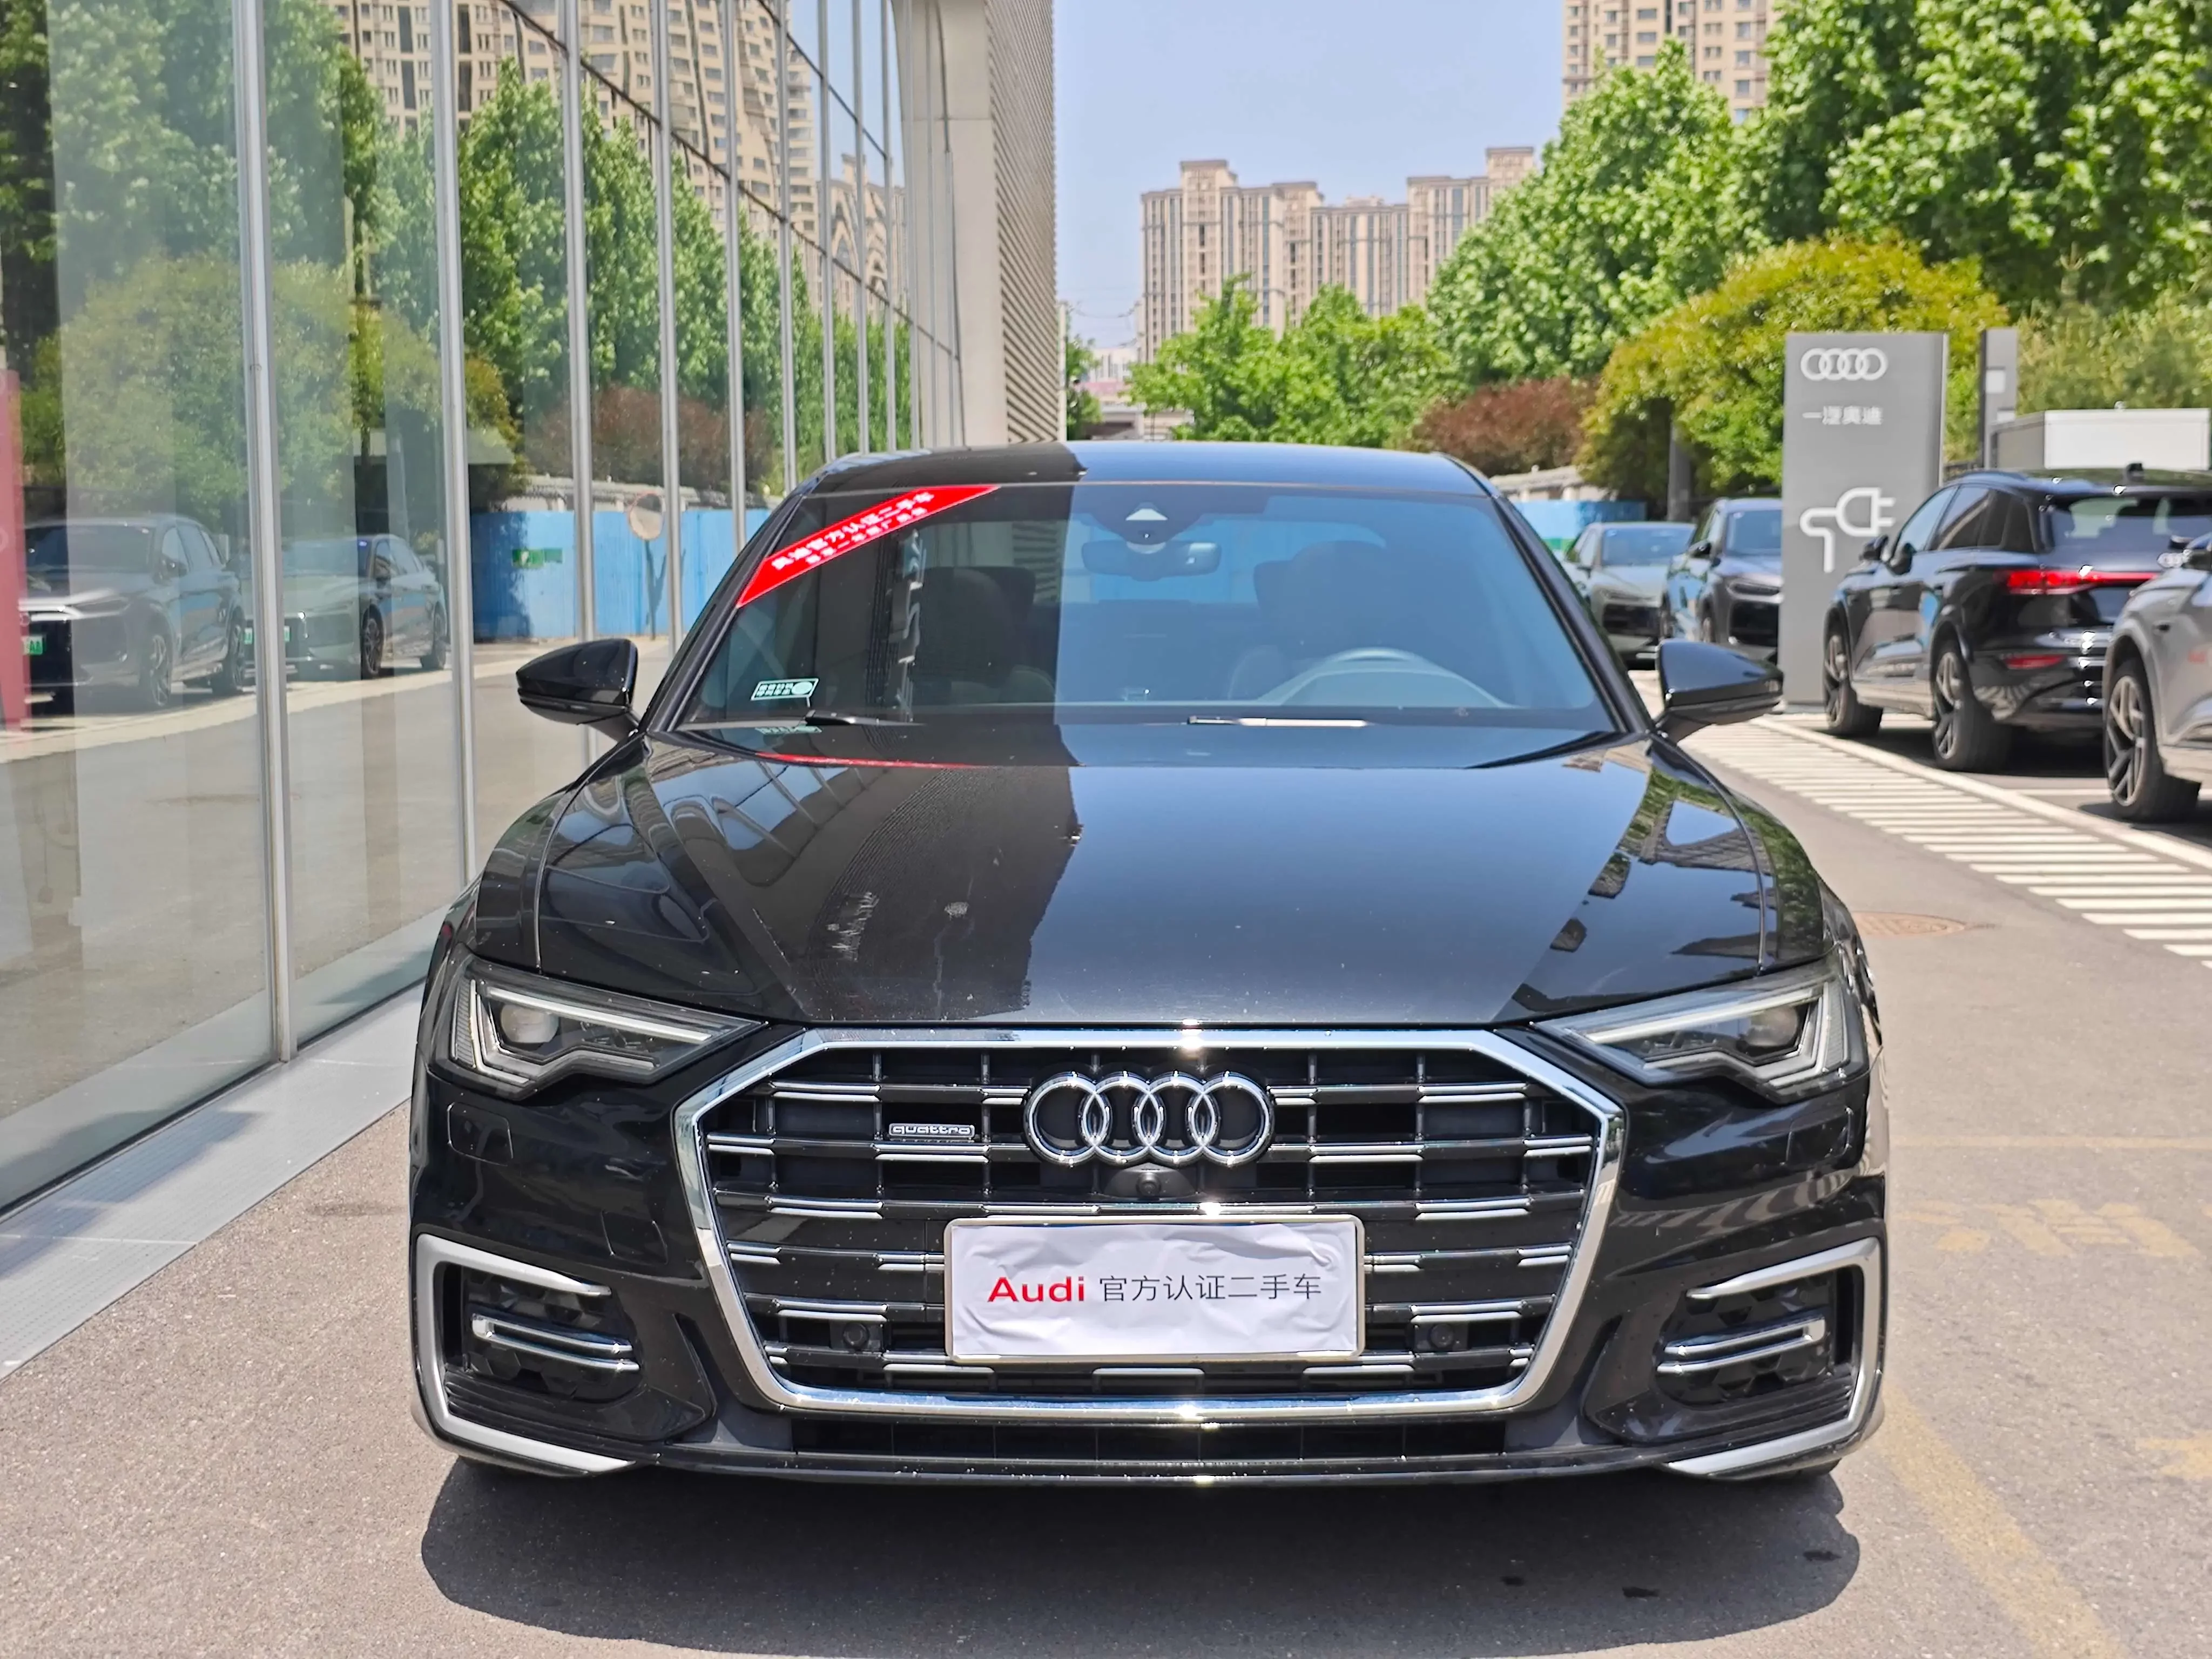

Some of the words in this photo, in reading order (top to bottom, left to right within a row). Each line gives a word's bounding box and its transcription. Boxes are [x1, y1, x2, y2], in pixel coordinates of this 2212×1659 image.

[892, 1125, 971, 1135] quattro
[988, 1276, 1084, 1303] Audi
[1100, 1274, 1321, 1301] 官方认证二手车
